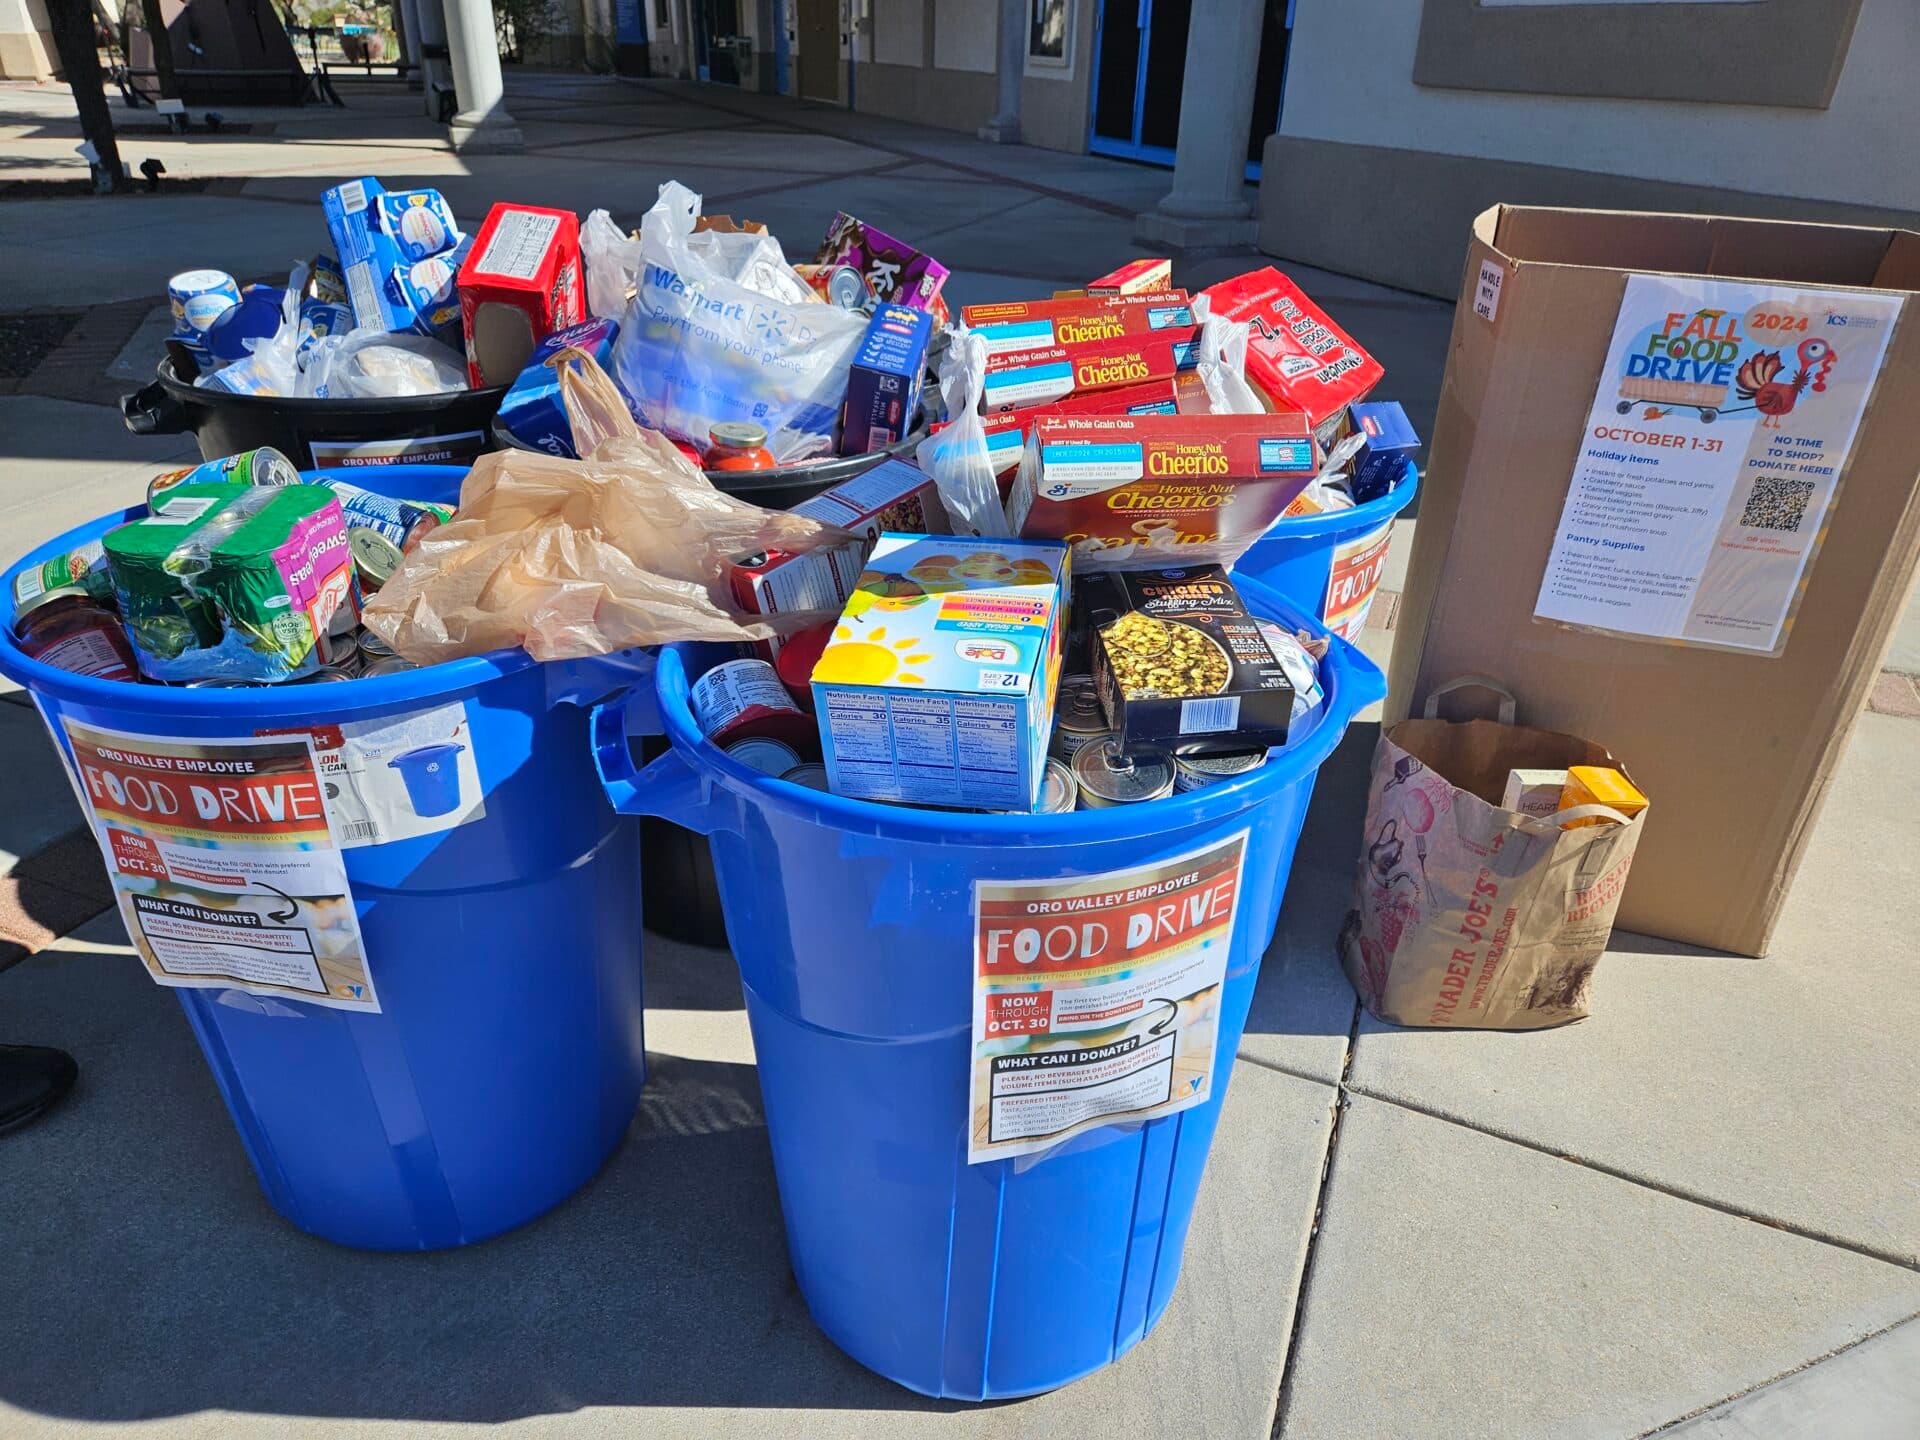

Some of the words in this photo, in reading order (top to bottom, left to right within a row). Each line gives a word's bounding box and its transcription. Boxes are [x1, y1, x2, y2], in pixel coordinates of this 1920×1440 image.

[1481, 269, 1500, 288] HANDLE
[1126, 296, 1147, 304] Whole
[1147, 294, 1164, 303] Grain
[1165, 293, 1181, 302] Oats
[1482, 286, 1494, 301] WITH
[1477, 302, 1491, 318] CARE
[1079, 316, 1102, 328] Honey
[1102, 314, 1118, 325] Nut
[1291, 316, 1318, 334] Soup
[1661, 312, 1743, 342] FALL
[1751, 313, 1809, 332] 2024
[652, 305, 677, 328] Pay
[723, 336, 761, 358] your
[1057, 321, 1125, 345] Cheerios
[1008, 354, 1030, 363] Whole
[1031, 352, 1050, 361] Grain
[1050, 349, 1067, 357] Oats
[1646, 334, 1739, 363] FOOD
[1101, 356, 1124, 367] Honey
[1124, 352, 1142, 364] Nut
[1078, 359, 1149, 387] Cheerios
[1315, 355, 1362, 384] Maruchan
[1626, 354, 1735, 386] DRIVE
[1067, 419, 1093, 429] Whole
[1094, 419, 1117, 429] Grain
[1117, 419, 1135, 429] Oats
[1594, 426, 1687, 449] OCTOBER
[1691, 437, 1724, 453] 1-31
[1774, 435, 1793, 445] NO
[1795, 438, 1824, 448] TIME
[1176, 444, 1204, 456] Honey
[1205, 444, 1223, 454] Nut
[1587, 449, 1627, 464] Holiday
[1629, 454, 1660, 466] items
[1767, 448, 1783, 458] TO
[1785, 450, 1824, 461] SHOP?
[343, 458, 364, 467] ORO
[364, 456, 401, 466] VALLEY
[402, 451, 452, 464] EMPLOYEE
[1149, 452, 1229, 476] Cheerios
[1748, 459, 1796, 472] DONATE
[1799, 464, 1834, 476] HERE!
[1588, 476, 1624, 488] Cranberry
[1645, 476, 1678, 486] potatoes
[1678, 479, 1693, 488] and
[1159, 485, 1204, 497] Honey
[1208, 484, 1236, 493] Nut
[1586, 485, 1615, 495] Canned
[1107, 491, 1238, 509] Cheerios
[1579, 510, 1607, 520] Canned
[1625, 508, 1653, 518] canned
[1576, 518, 1601, 528] Cream
[309, 528, 348, 560] Sweet
[1566, 533, 1600, 546] Pantry
[1602, 538, 1646, 552] Supplies
[1143, 585, 1224, 597] CHICKEN
[1329, 565, 1373, 609] FOOD
[1145, 598, 1200, 609] Stuffing
[1201, 597, 1234, 606] Mix
[965, 648, 1007, 660] Dole
[826, 692, 861, 702] Nutrition
[862, 694, 885, 703] Facts
[889, 695, 925, 705] Nutrition
[926, 698, 949, 707] Facts
[953, 699, 989, 709] Nutrition
[991, 703, 1015, 711] Facts
[830, 711, 864, 721] Calories
[872, 711, 887, 721] 30
[892, 715, 928, 725] Calories
[935, 717, 950, 726] 35
[956, 720, 992, 729] Calories
[1000, 721, 1016, 731] 45
[97, 747, 123, 764] ORO
[124, 752, 173, 770] VALLEY
[175, 759, 255, 774] EMPLOYEE
[328, 762, 348, 772] CAN
[84, 764, 179, 816] FOOD
[189, 782, 321, 823] DRIVE
[1522, 801, 1558, 812] HEART
[121, 835, 147, 850] NOW
[118, 858, 149, 872] OCT.
[151, 863, 167, 876] 30
[1026, 900, 1064, 914] ORO
[1066, 893, 1123, 912] VALLEY
[1126, 871, 1200, 901] EMPLOYEE
[137, 898, 170, 912] WHAT
[172, 904, 195, 918] CAN
[196, 909, 202, 918] I
[203, 912, 257, 926] DONATE?
[986, 922, 1109, 965] FOOD
[1126, 879, 1235, 950] DRIVE
[1429, 947, 1477, 1025] TRADER
[1001, 996, 1038, 1008] NOW
[988, 1006, 1049, 1018] THROUGH
[1058, 1014, 1080, 1023] BRING
[1080, 1013, 1090, 1022] ON
[1091, 1011, 1105, 1020] THE
[1104, 1002, 1142, 1017] DONATIONS!
[988, 1019, 1025, 1032] OCT.
[1028, 1018, 1049, 1030] 30
[997, 1056, 1037, 1070] WHAT
[1041, 1053, 1069, 1066] CAN
[1070, 1051, 1077, 1063] I
[1079, 1039, 1137, 1062] DONATE?
[1001, 1073, 1034, 1083] PLEASE,
[1034, 1073, 1045, 1081] NO
[1045, 1069, 1091, 1080] BEVERAGES
[1091, 1067, 1102, 1075] OR
[1103, 1060, 1126, 1071] LARGE
[1000, 1083, 1033, 1091] VOLUME
[1033, 1080, 1058, 1089] ITEMS
[1000, 1098, 1045, 1106] PREFERRED
